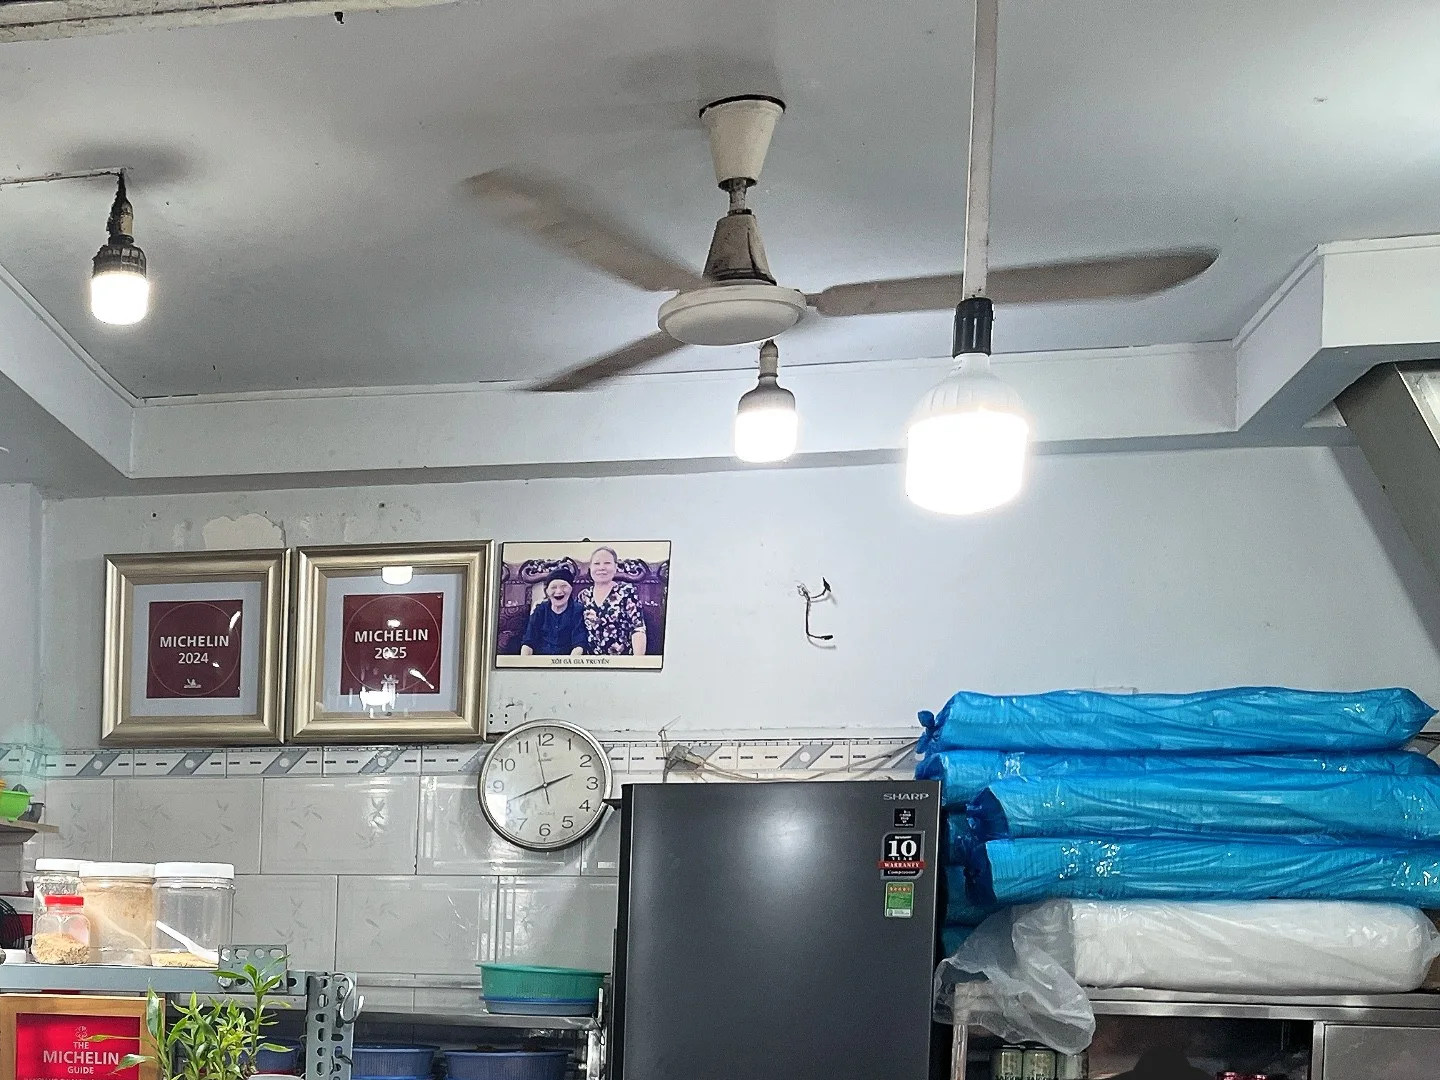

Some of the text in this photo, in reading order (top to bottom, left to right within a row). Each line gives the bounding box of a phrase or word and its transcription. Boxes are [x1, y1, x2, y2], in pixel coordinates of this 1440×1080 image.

[160, 635, 229, 648] MICHELIN
[354, 629, 428, 642] MICHELIN
[178, 652, 208, 664] 2024
[374, 647, 407, 659] 2025
[538, 733, 554, 746] 12
[568, 738, 572, 751] 1
[517, 740, 529, 753] 11
[499, 758, 515, 771] 10
[580, 755, 592, 767] 2
[586, 777, 598, 790] 3
[579, 800, 590, 812] 4
[562, 816, 574, 828] 5
[539, 823, 551, 836] 6
[888, 840, 917, 857] 10
[73, 1041, 89, 1049] THE
[43, 1051, 119, 1065] MICHELIN
[67, 1066, 94, 1074] GUIDE
